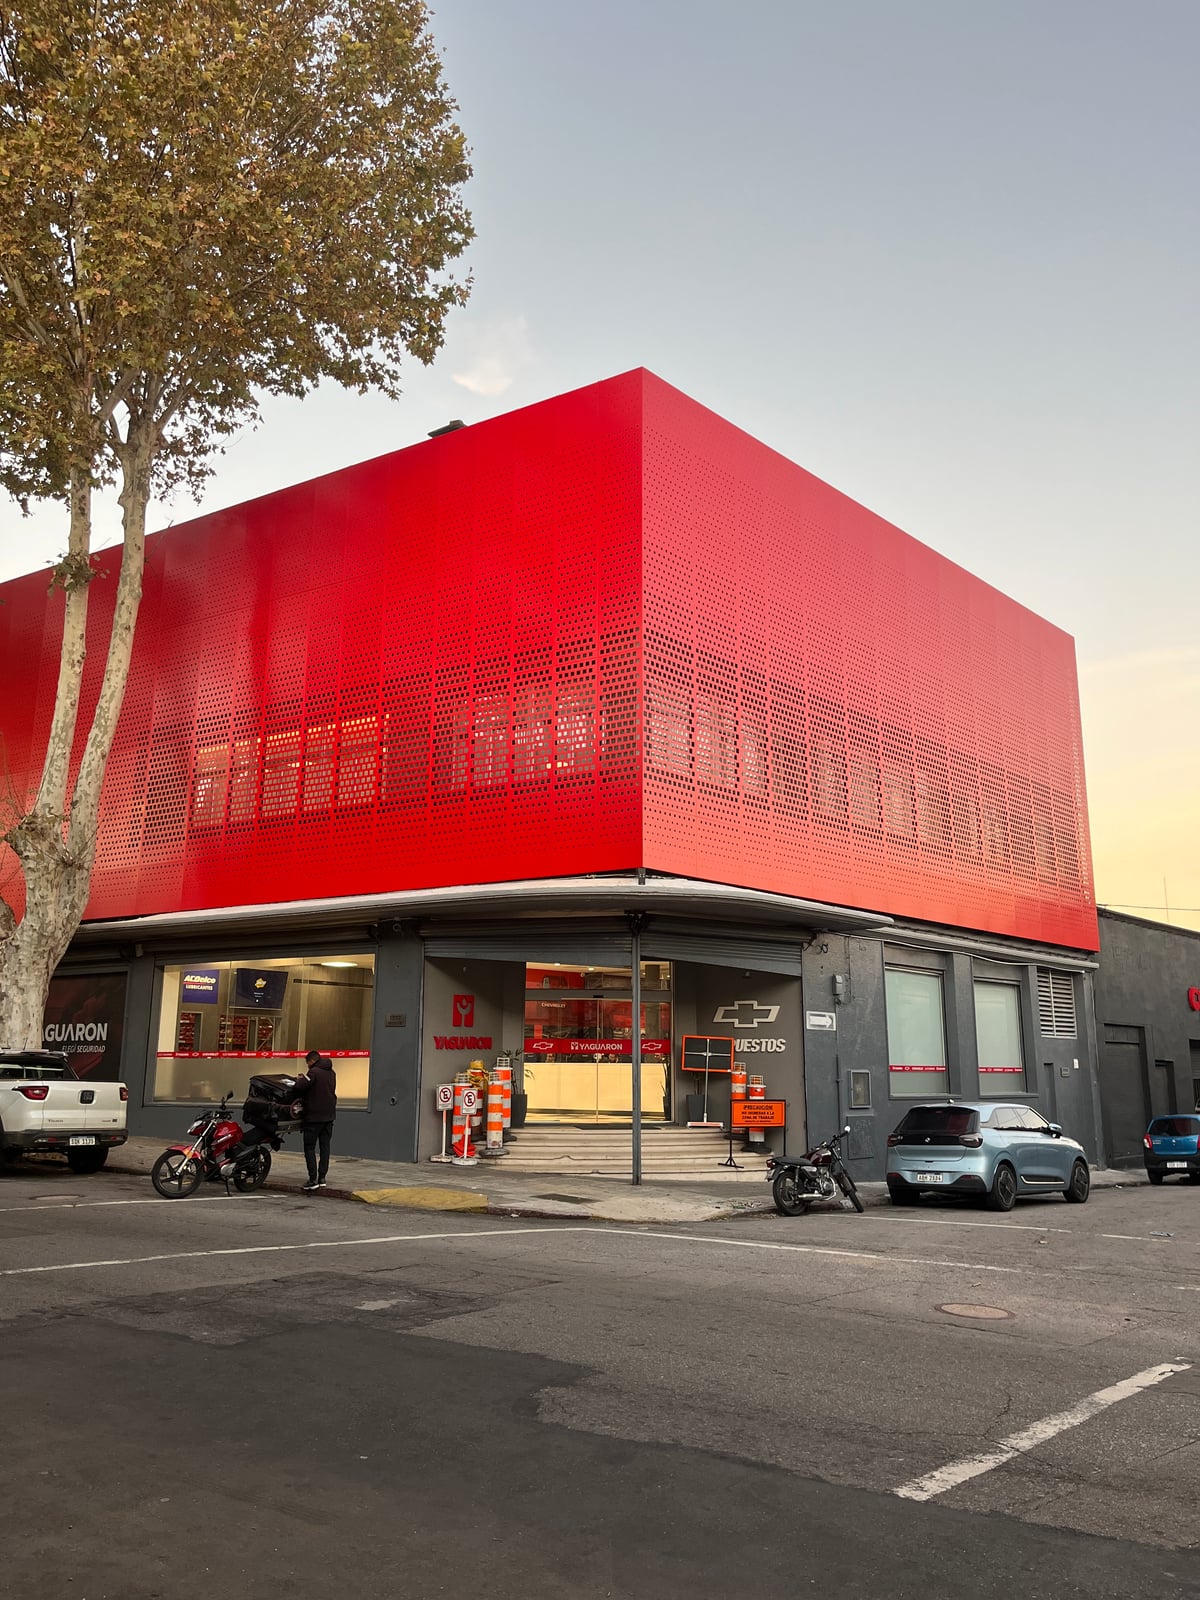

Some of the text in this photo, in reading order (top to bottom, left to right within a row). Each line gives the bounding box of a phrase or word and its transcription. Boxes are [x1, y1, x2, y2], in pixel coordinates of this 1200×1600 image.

[184, 975, 216, 984] ACDelco
[42, 1023, 108, 1042] GUARON
[433, 1036, 493, 1050] YAGUARON
[734, 1038, 786, 1052] UESTOS
